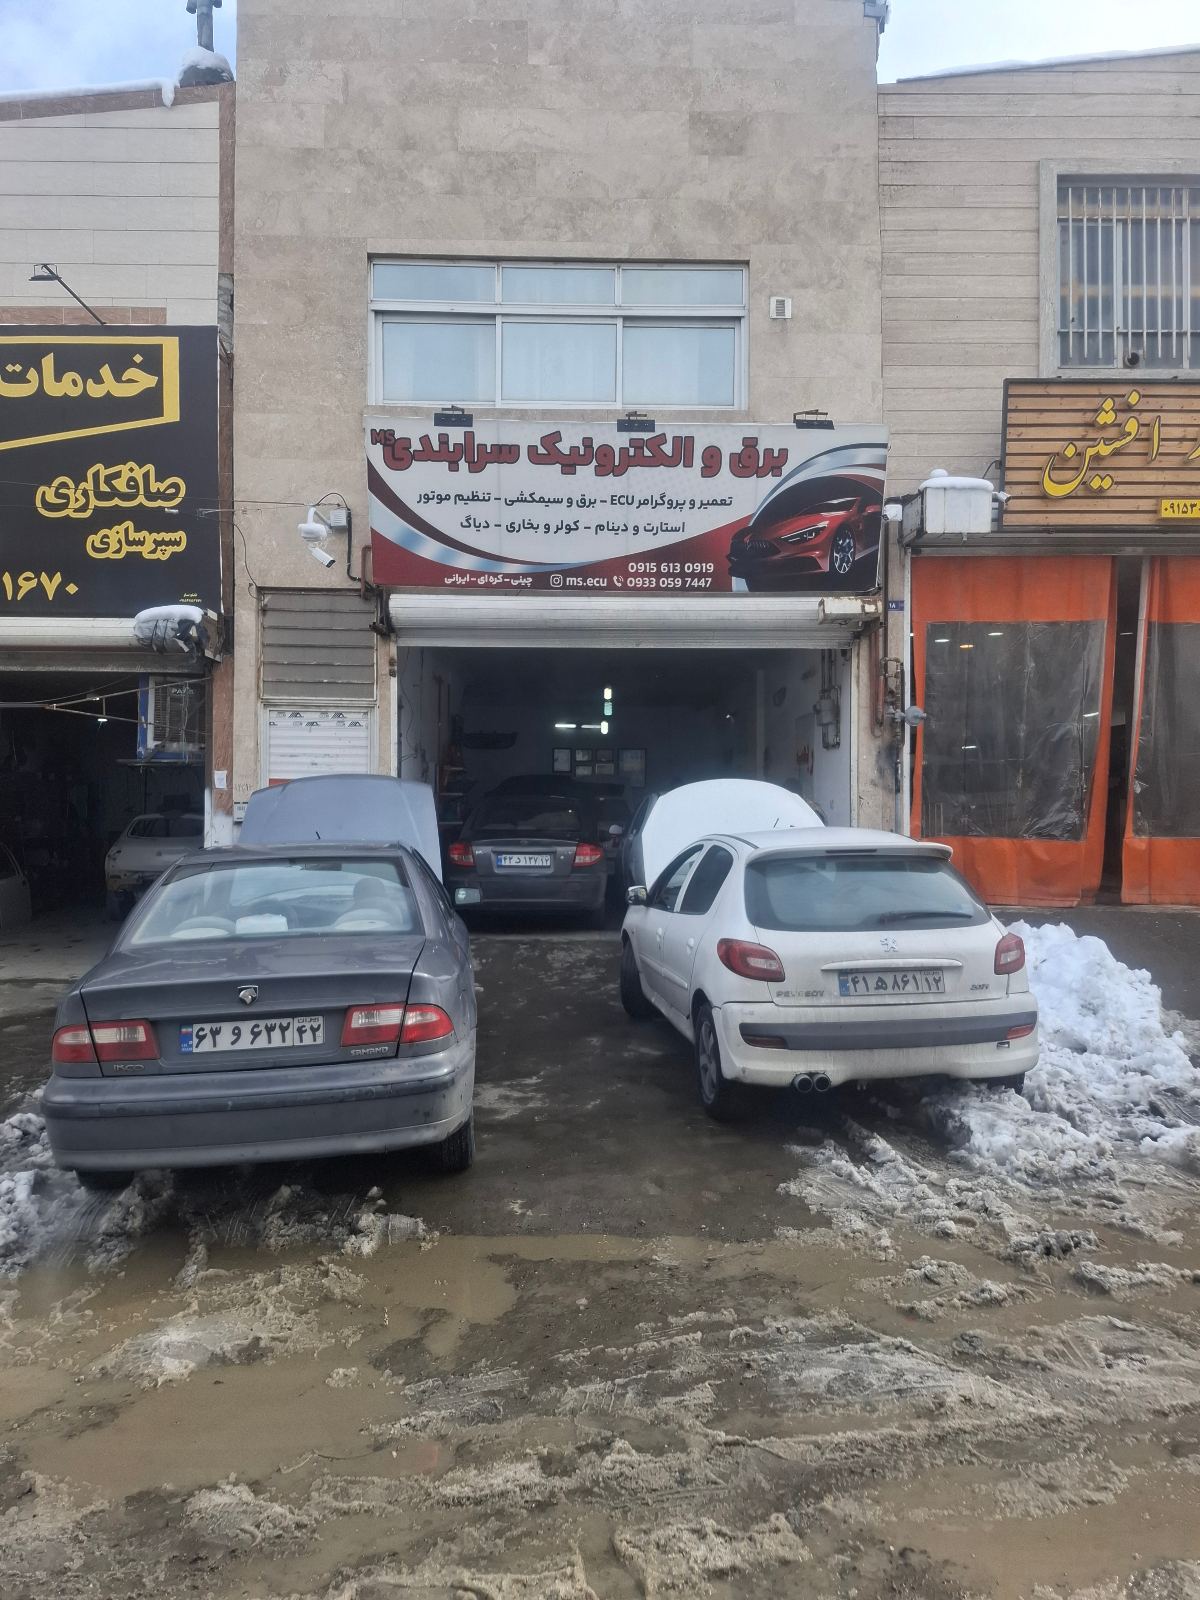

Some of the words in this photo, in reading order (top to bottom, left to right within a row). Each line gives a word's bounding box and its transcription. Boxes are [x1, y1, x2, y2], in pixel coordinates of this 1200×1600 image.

[0, 352, 159, 398] خدمات
[370, 428, 396, 446] MS
[1042, 389, 1161, 498] افشین
[382, 431, 520, 474] سرابندی
[527, 431, 695, 477] الکترونیک
[729, 437, 788, 478] برق
[700, 445, 722, 478] و
[35, 461, 186, 518] صافکاری
[417, 491, 451, 504] موتور
[454, 491, 491, 505] تنظیم
[504, 491, 564, 507] سیمکشی
[566, 496, 573, 508] و
[576, 493, 597, 509] برق
[610, 495, 635, 506] ECU
[636, 492, 686, 512] پروگرامر
[688, 499, 696, 510] و
[697, 496, 733, 510] تعمیر
[460, 514, 490, 532] دیاگ
[505, 519, 540, 534] بخاری
[543, 523, 551, 534] و
[553, 519, 580, 534] کولر
[595, 521, 629, 535] دینام
[632, 524, 640, 536] و
[643, 521, 686, 536] استارت
[628, 562, 657, 573] 0915
[660, 562, 681, 573] 613
[684, 562, 714, 573] 0919
[1, 571, 79, 601] ۱۶۷۰
[566, 577, 607, 587] ms.ecu
[627, 577, 656, 588] 0933
[659, 577, 682, 588] 059
[685, 577, 712, 588] 7447
[850, 975, 870, 993] ۴۱
[892, 974, 920, 991] ۸۶۱
[925, 976, 941, 991] ۱۲
[195, 1025, 222, 1049] ۶۳
[230, 1025, 242, 1046] و
[249, 1021, 291, 1046] ۶۳۲
[296, 1023, 322, 1044] ۴۲
